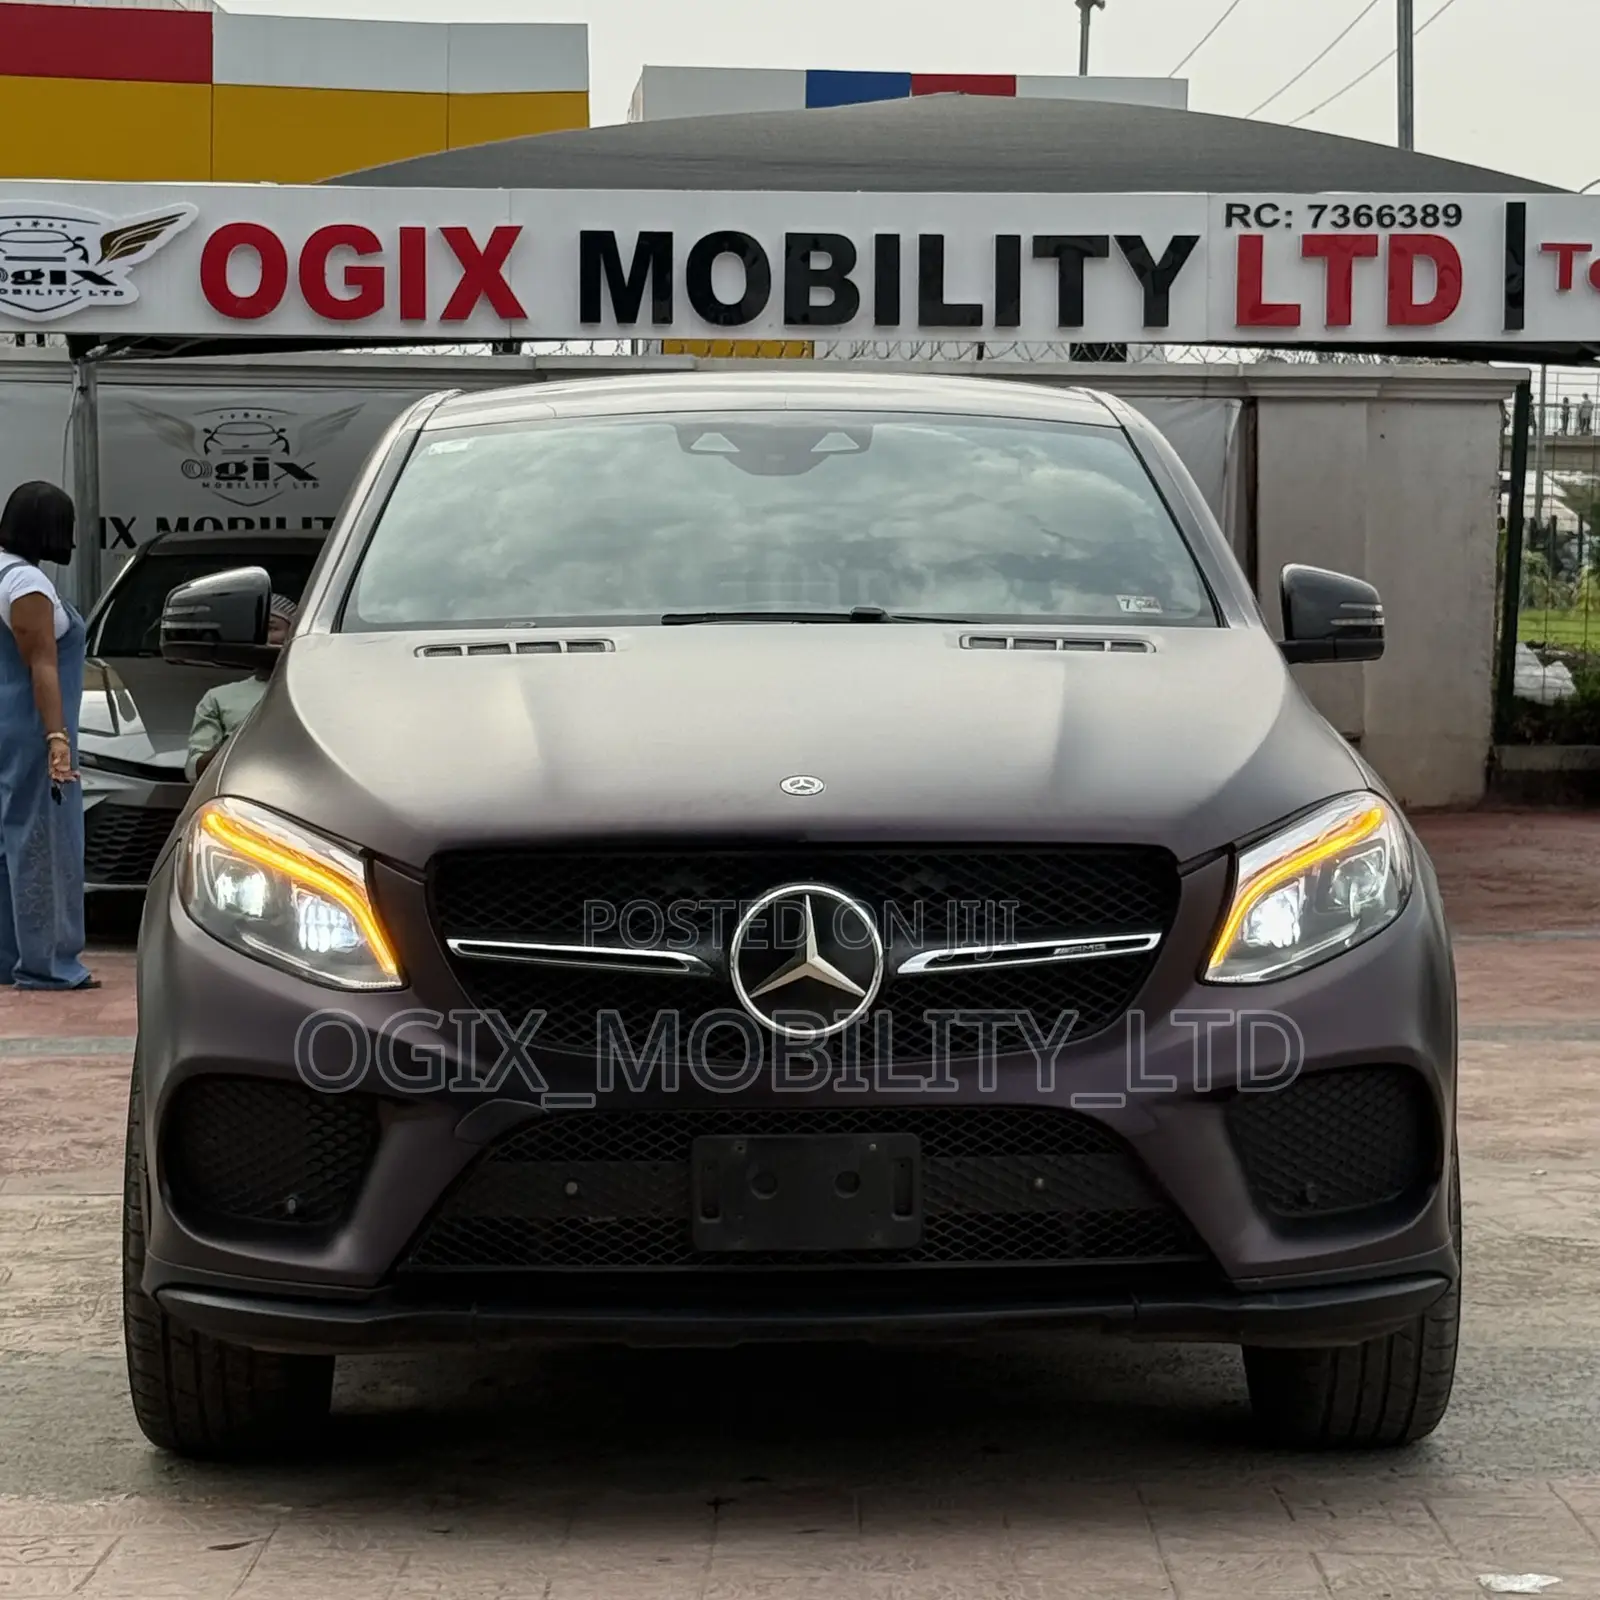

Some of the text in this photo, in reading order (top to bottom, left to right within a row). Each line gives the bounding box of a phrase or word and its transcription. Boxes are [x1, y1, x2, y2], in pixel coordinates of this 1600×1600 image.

[1225, 203, 1463, 229] RC: 7366389
[200, 221, 1463, 328] OGIX MOBILITY LTD
[0, 288, 80, 296] OBILITY
